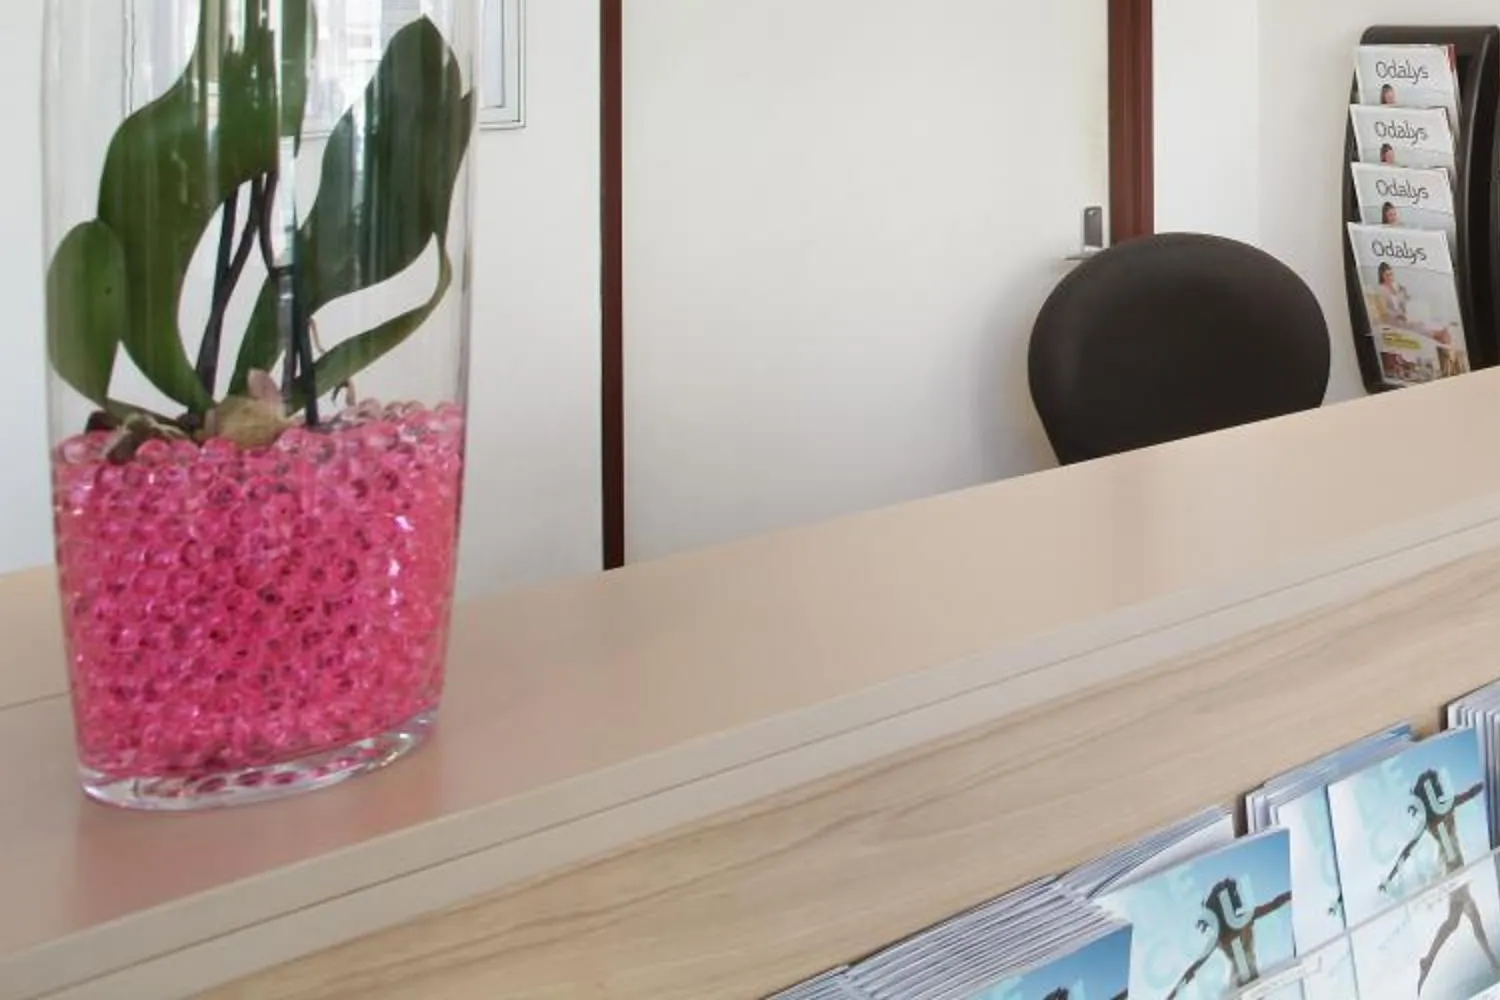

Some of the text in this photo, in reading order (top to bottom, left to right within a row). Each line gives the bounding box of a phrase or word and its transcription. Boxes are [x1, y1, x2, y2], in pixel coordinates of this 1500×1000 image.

[1375, 61, 1429, 89] Odalys
[1374, 121, 1428, 148] Odalys
[1376, 180, 1429, 207] Odalys
[1372, 240, 1427, 267] Odalys
